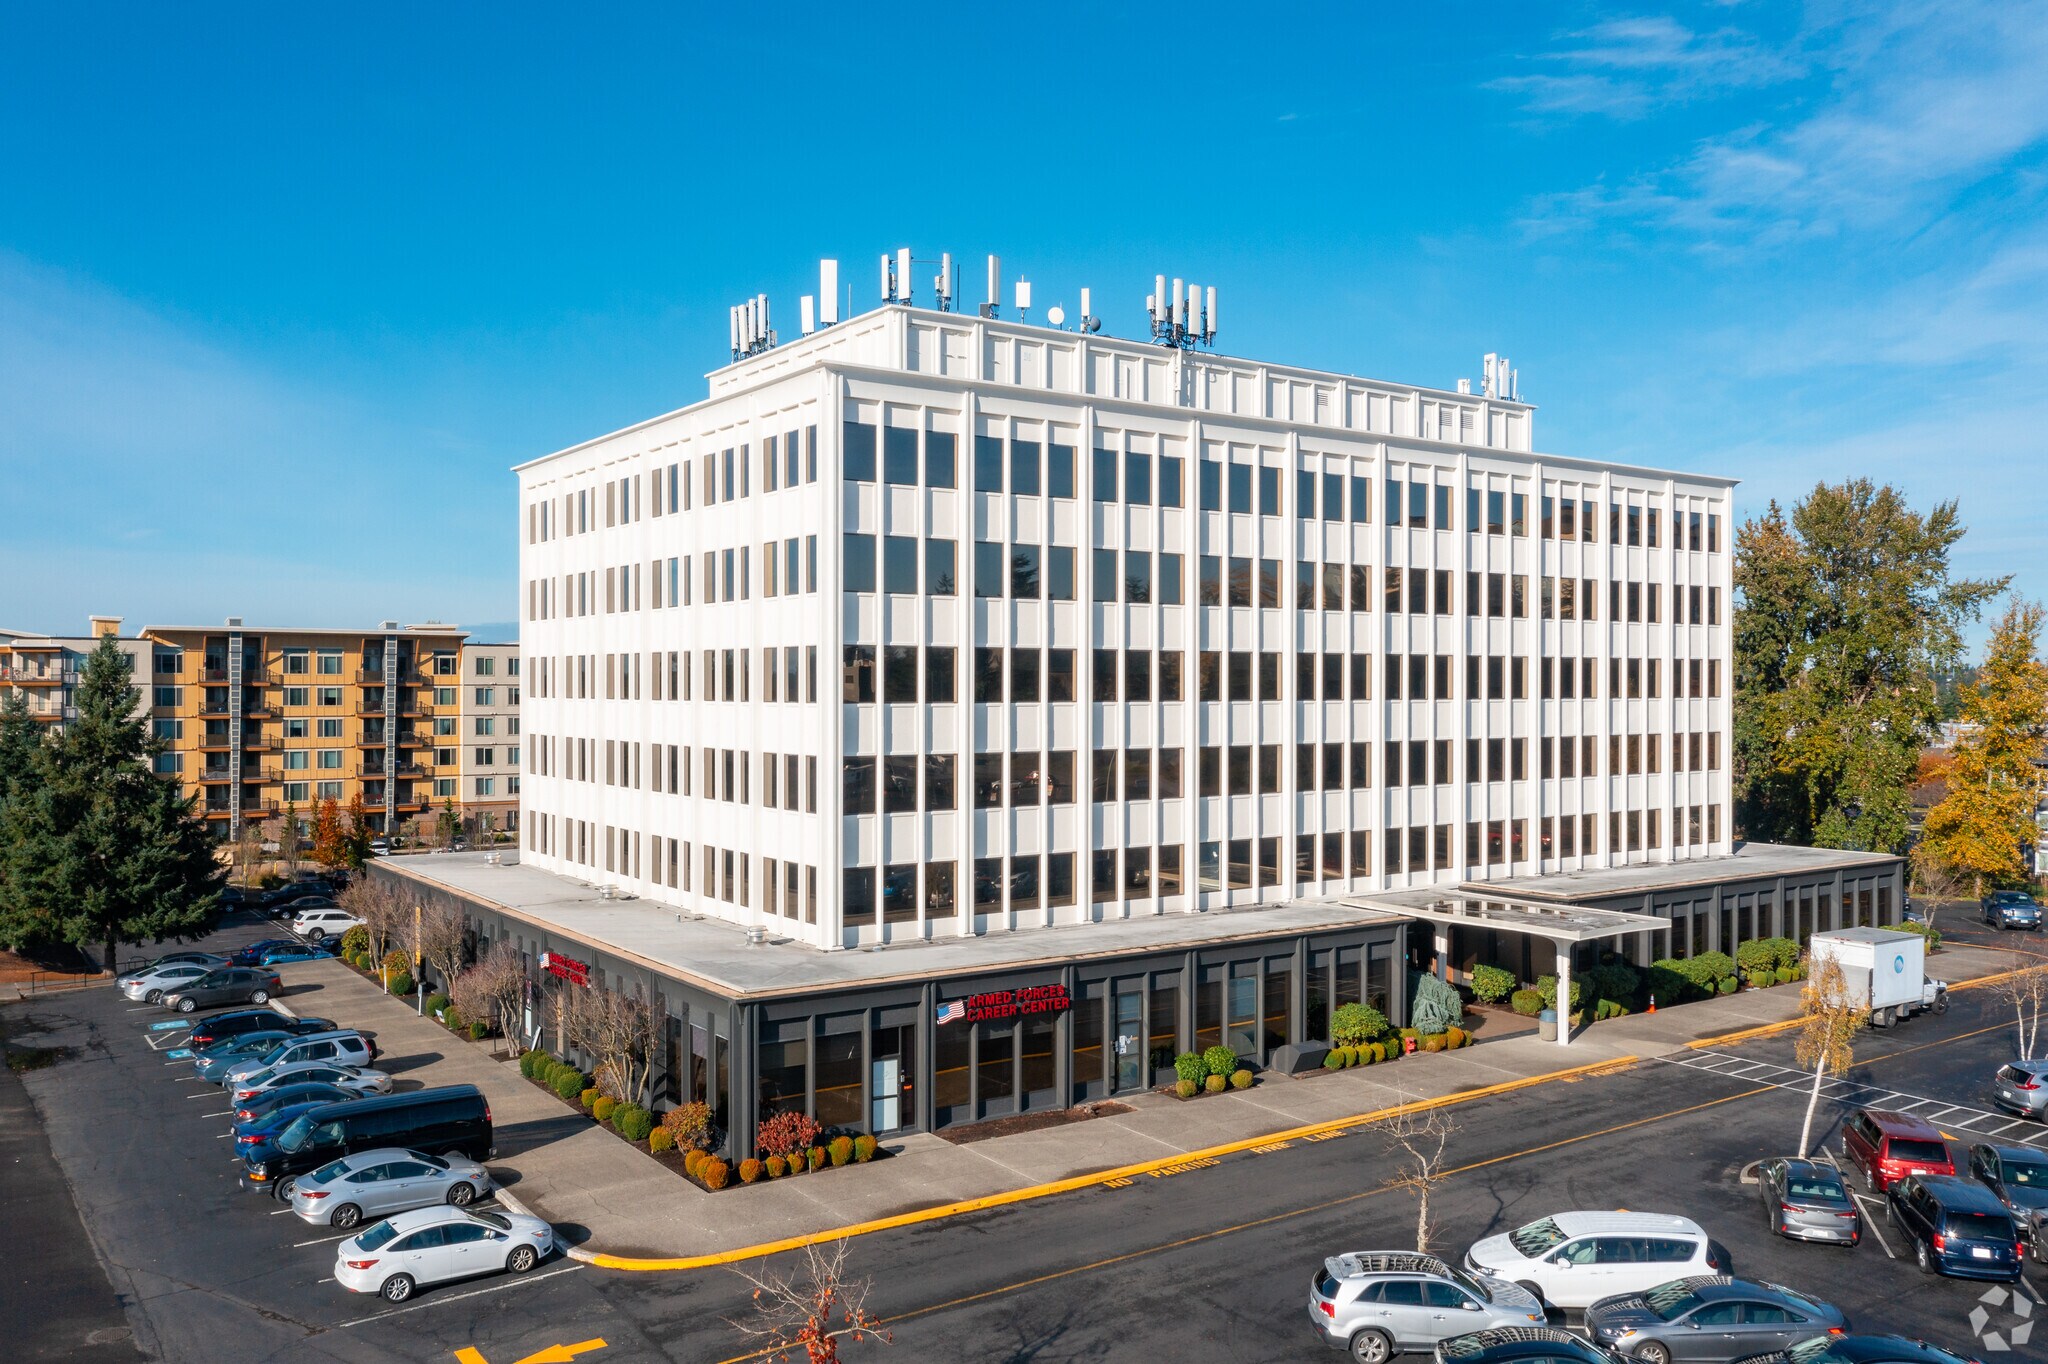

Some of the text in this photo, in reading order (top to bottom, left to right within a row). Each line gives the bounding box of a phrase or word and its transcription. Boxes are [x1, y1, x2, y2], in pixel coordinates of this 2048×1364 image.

[967, 984, 1066, 1008] ARMED FORCES
[967, 997, 1070, 1022] CAREER CENTER
[1102, 1128, 1347, 1189] NO PARKING FIRE LANE
